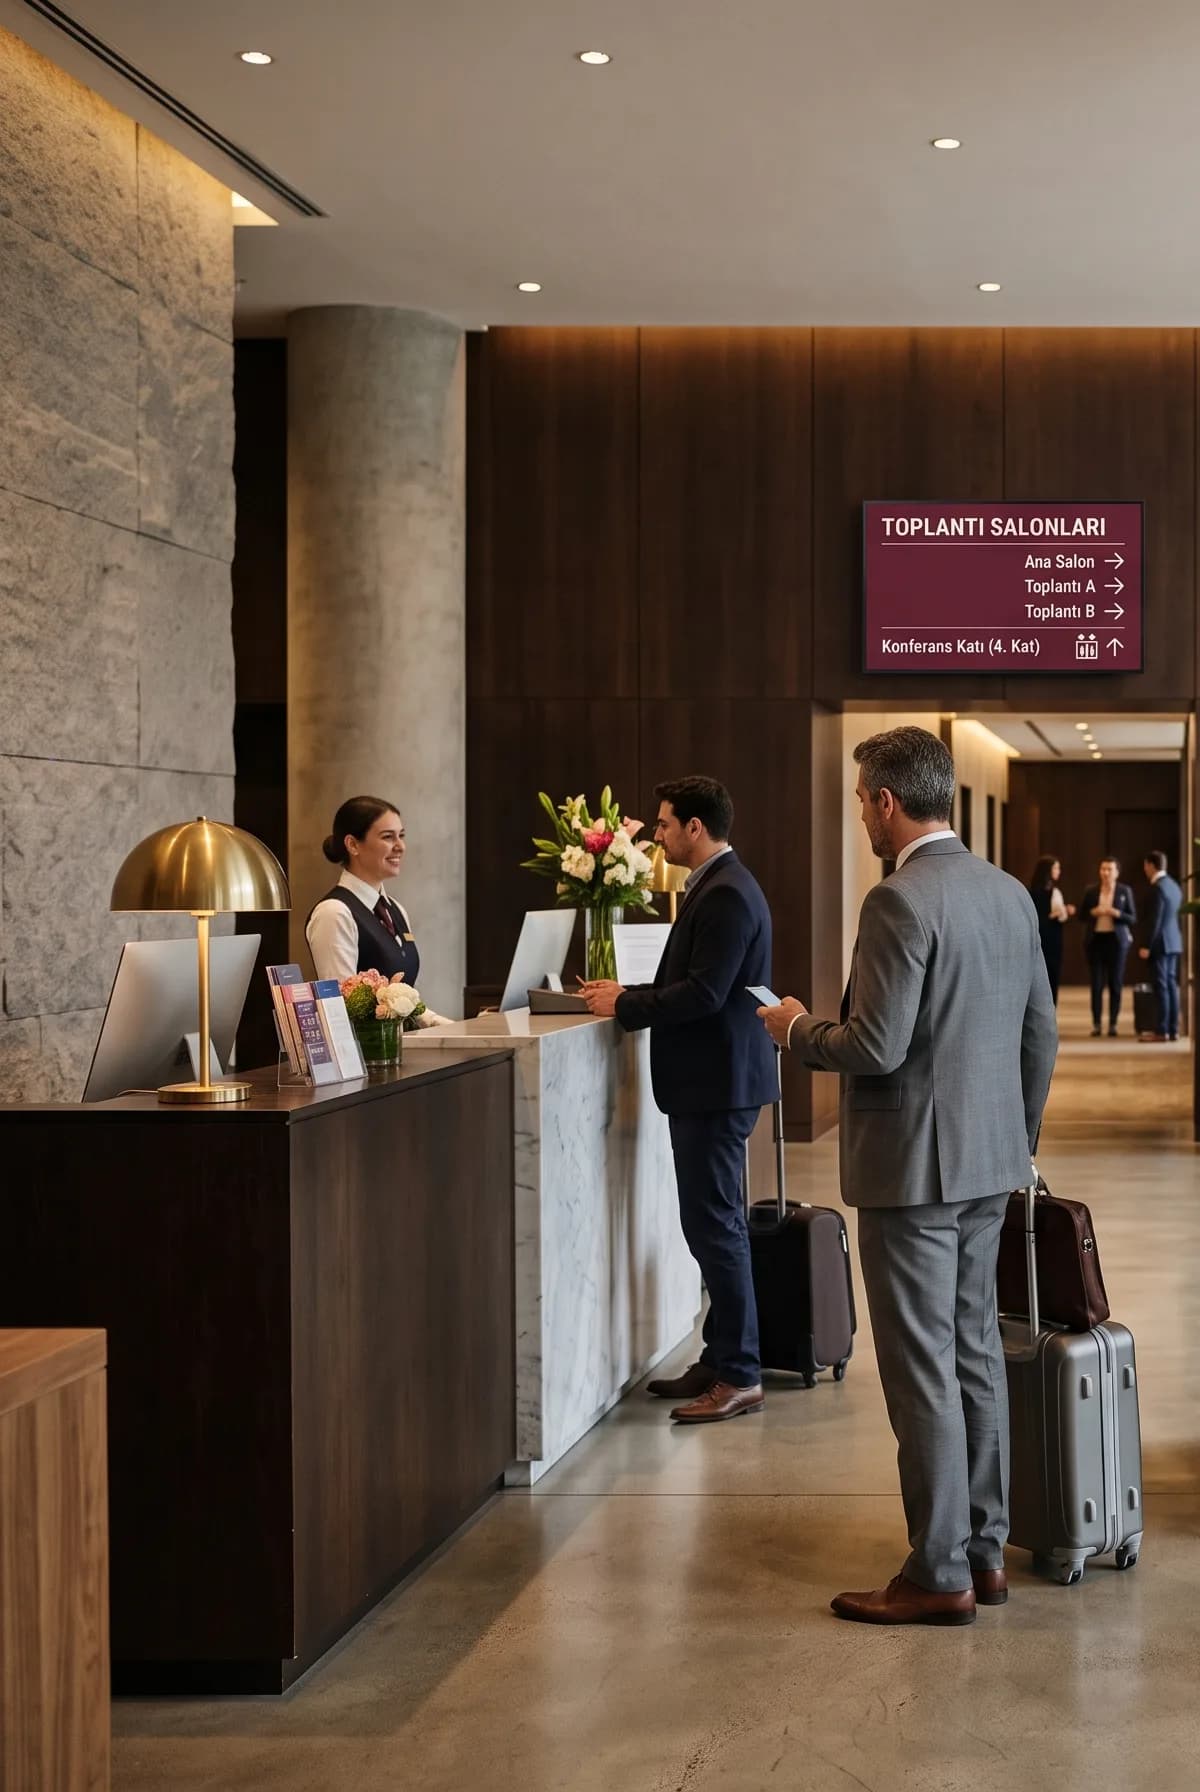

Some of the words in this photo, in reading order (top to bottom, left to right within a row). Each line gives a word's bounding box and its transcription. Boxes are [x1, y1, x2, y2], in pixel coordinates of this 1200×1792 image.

[881, 517, 984, 537] TOPLANTI
[990, 517, 1106, 537] SALONLARI
[1024, 554, 1052, 569] Ana
[1055, 553, 1095, 569] Salon
[1024, 578, 1081, 597] Toplantı
[1085, 579, 1097, 593] A
[1024, 603, 1081, 622] Toplantı
[1085, 603, 1096, 619] B
[882, 638, 953, 654] Konferans
[956, 639, 984, 654] Katı
[988, 638, 1007, 657] (4.
[1011, 638, 1040, 657] Kat)
